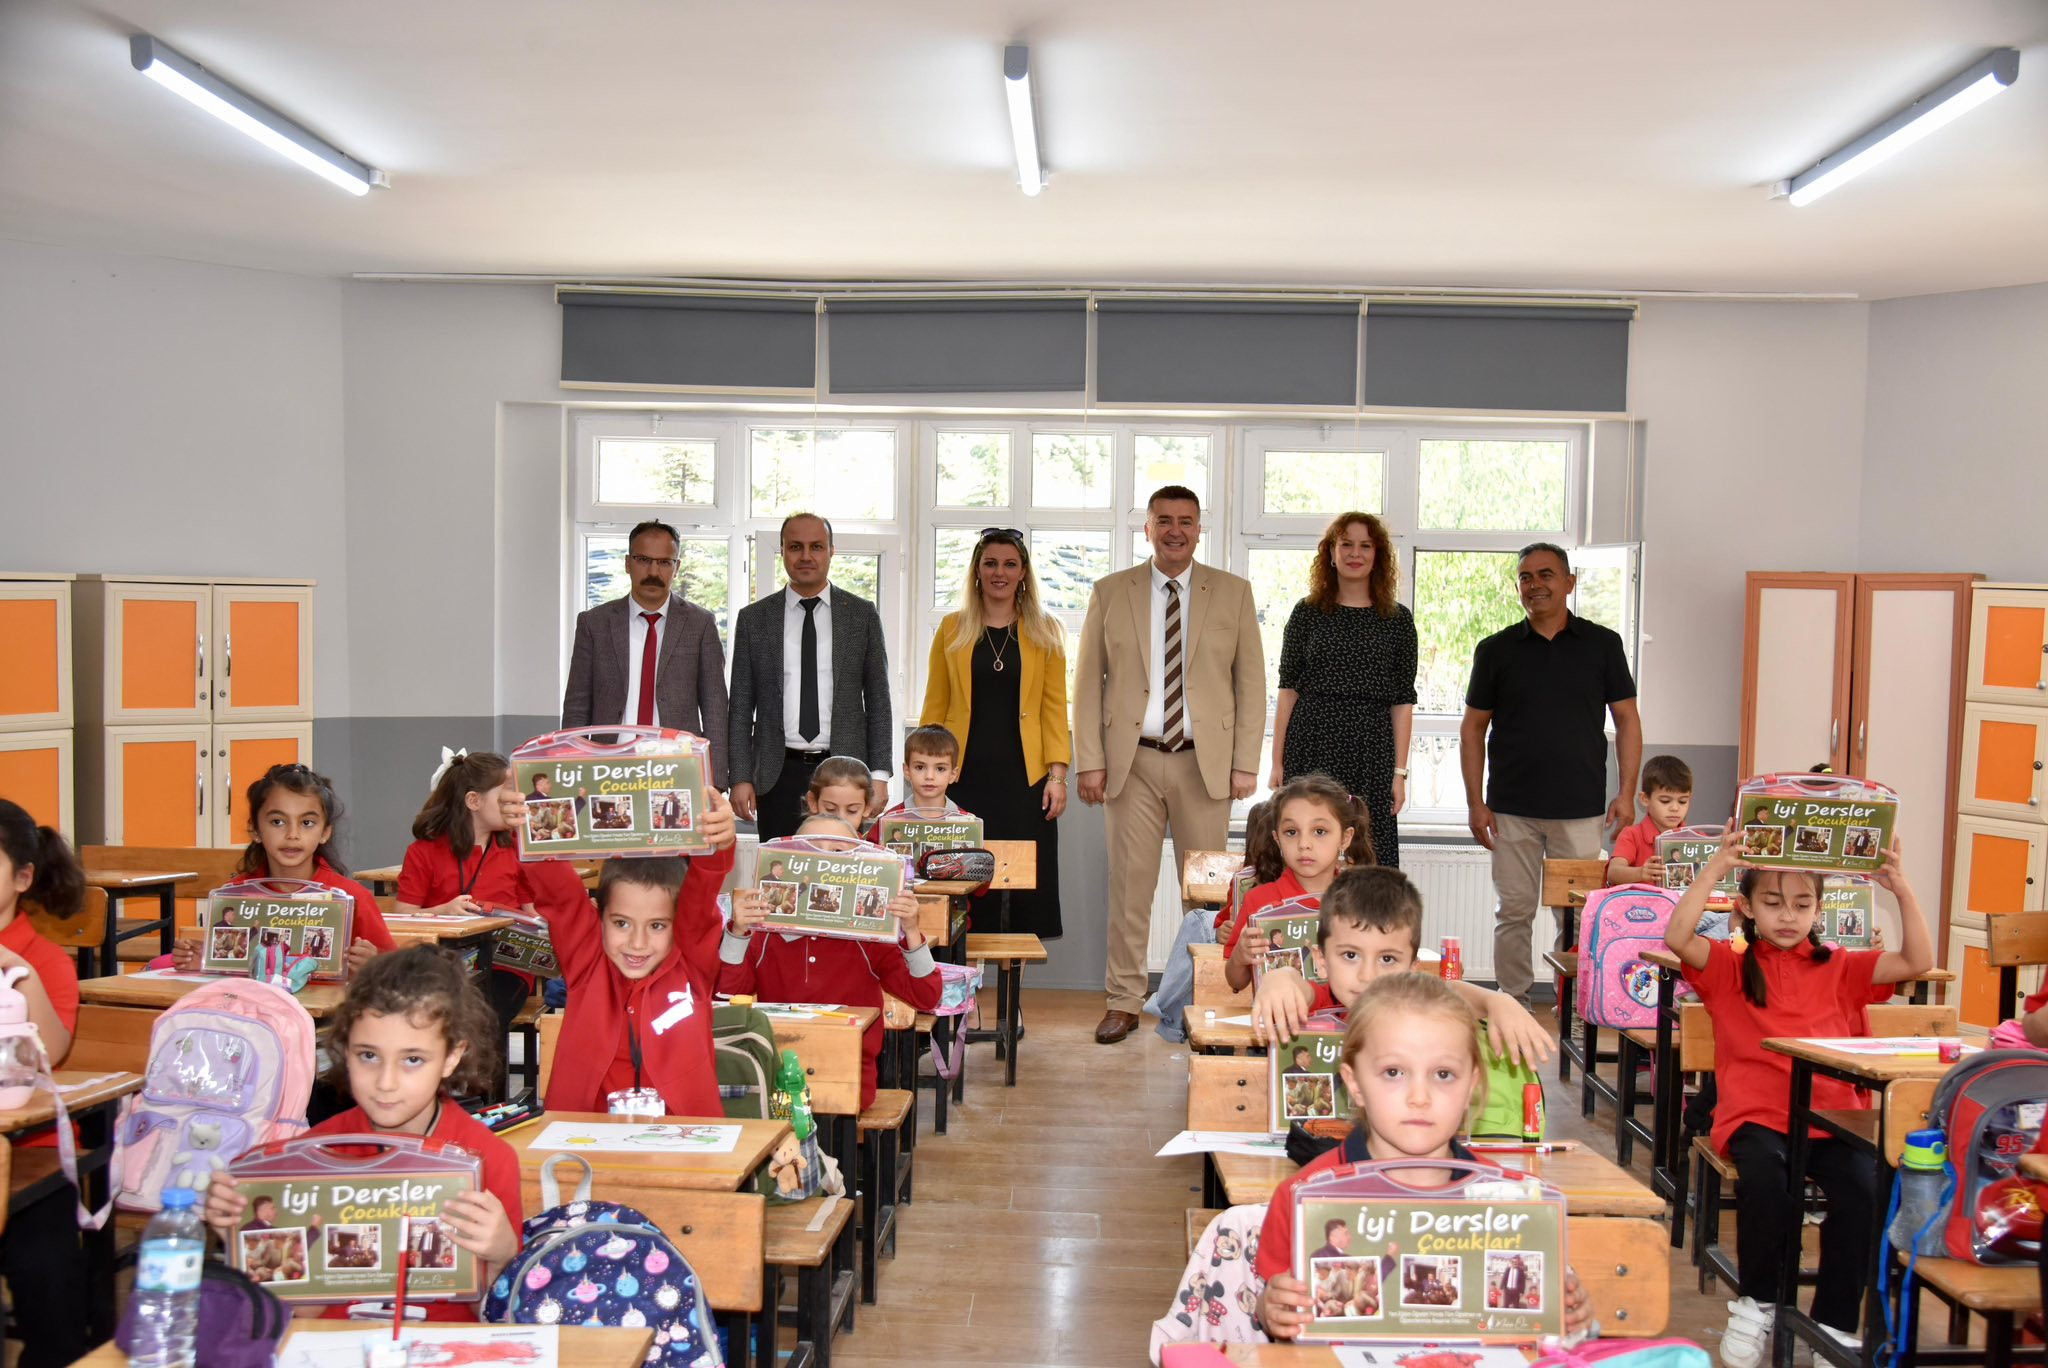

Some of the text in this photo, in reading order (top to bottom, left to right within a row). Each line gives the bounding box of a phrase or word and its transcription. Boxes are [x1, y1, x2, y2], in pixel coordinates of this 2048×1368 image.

[555, 760, 678, 787] İyi Dersler
[600, 777, 675, 795] Çocuklar!
[1773, 800, 1876, 819] İyi Dersler
[904, 824, 969, 837] İyi Dersler
[1808, 816, 1870, 827] Çocuklar!
[1683, 843, 1699, 857] İyi
[788, 855, 883, 875] İyi Dersler
[1823, 889, 1858, 900] rsler
[239, 901, 328, 919] İyi Dersler
[270, 916, 324, 928] Çocuklar!
[1287, 920, 1308, 939] İyi
[508, 932, 553, 948] Dersle
[1316, 1037, 1344, 1063] İyi
[1996, 1134, 2024, 1155] 95
[282, 1180, 443, 1215] İyi Dersler
[1357, 1206, 1529, 1242] İyi Dersler
[1418, 1232, 1522, 1254] Çocuklar!
